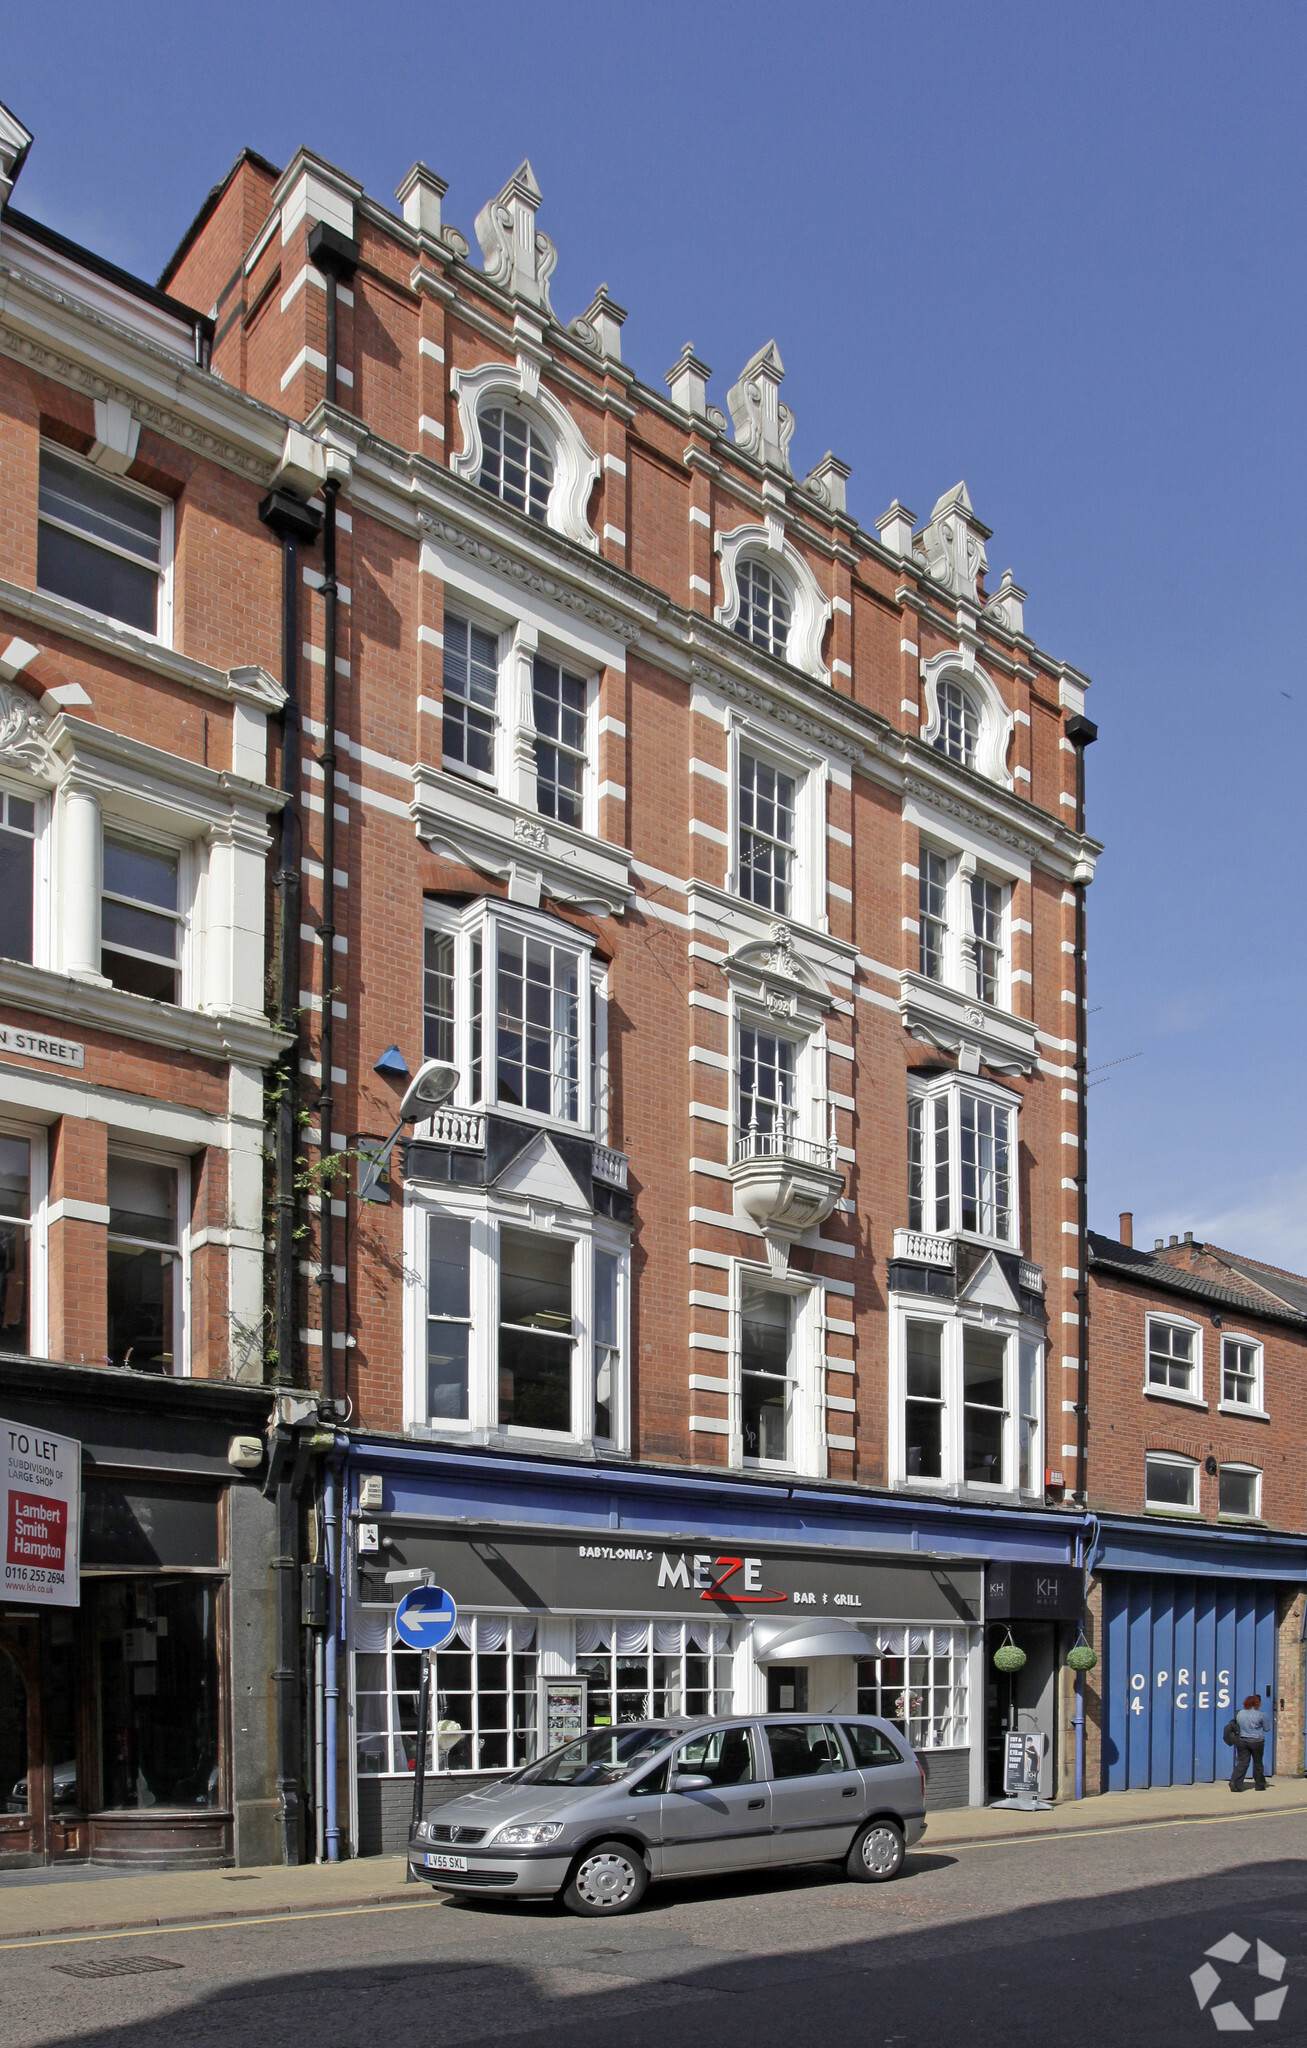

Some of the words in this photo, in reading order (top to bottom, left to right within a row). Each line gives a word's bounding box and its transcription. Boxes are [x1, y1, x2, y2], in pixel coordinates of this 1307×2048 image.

[16, 1035, 78, 1060] STREET
[8, 1431, 30, 1454] TO
[35, 1438, 58, 1462] LET
[8, 1457, 55, 1477] SUBDIVISION
[55, 1470, 63, 1480] OF
[8, 1468, 34, 1483] LARGE
[35, 1475, 54, 1488] SHOP
[15, 1499, 61, 1524] Lambert
[15, 1519, 48, 1539] Smith
[14, 1536, 62, 1559] Hampton
[5, 1566, 28, 1580] 0116
[29, 1569, 46, 1582] 255
[47, 1571, 65, 1584] 2694
[657, 1551, 764, 1600] MEZE
[793, 1591, 817, 1604] BAR
[833, 1594, 862, 1607] GRILL
[5, 1582, 54, 1594] www.lsh.co.uk
[989, 1582, 1004, 1593] KH
[1036, 1578, 1059, 1596] KH
[1131, 1696, 1144, 1715] 4
[429, 1855, 447, 1867] LV55
[449, 1858, 464, 1868] SXL
